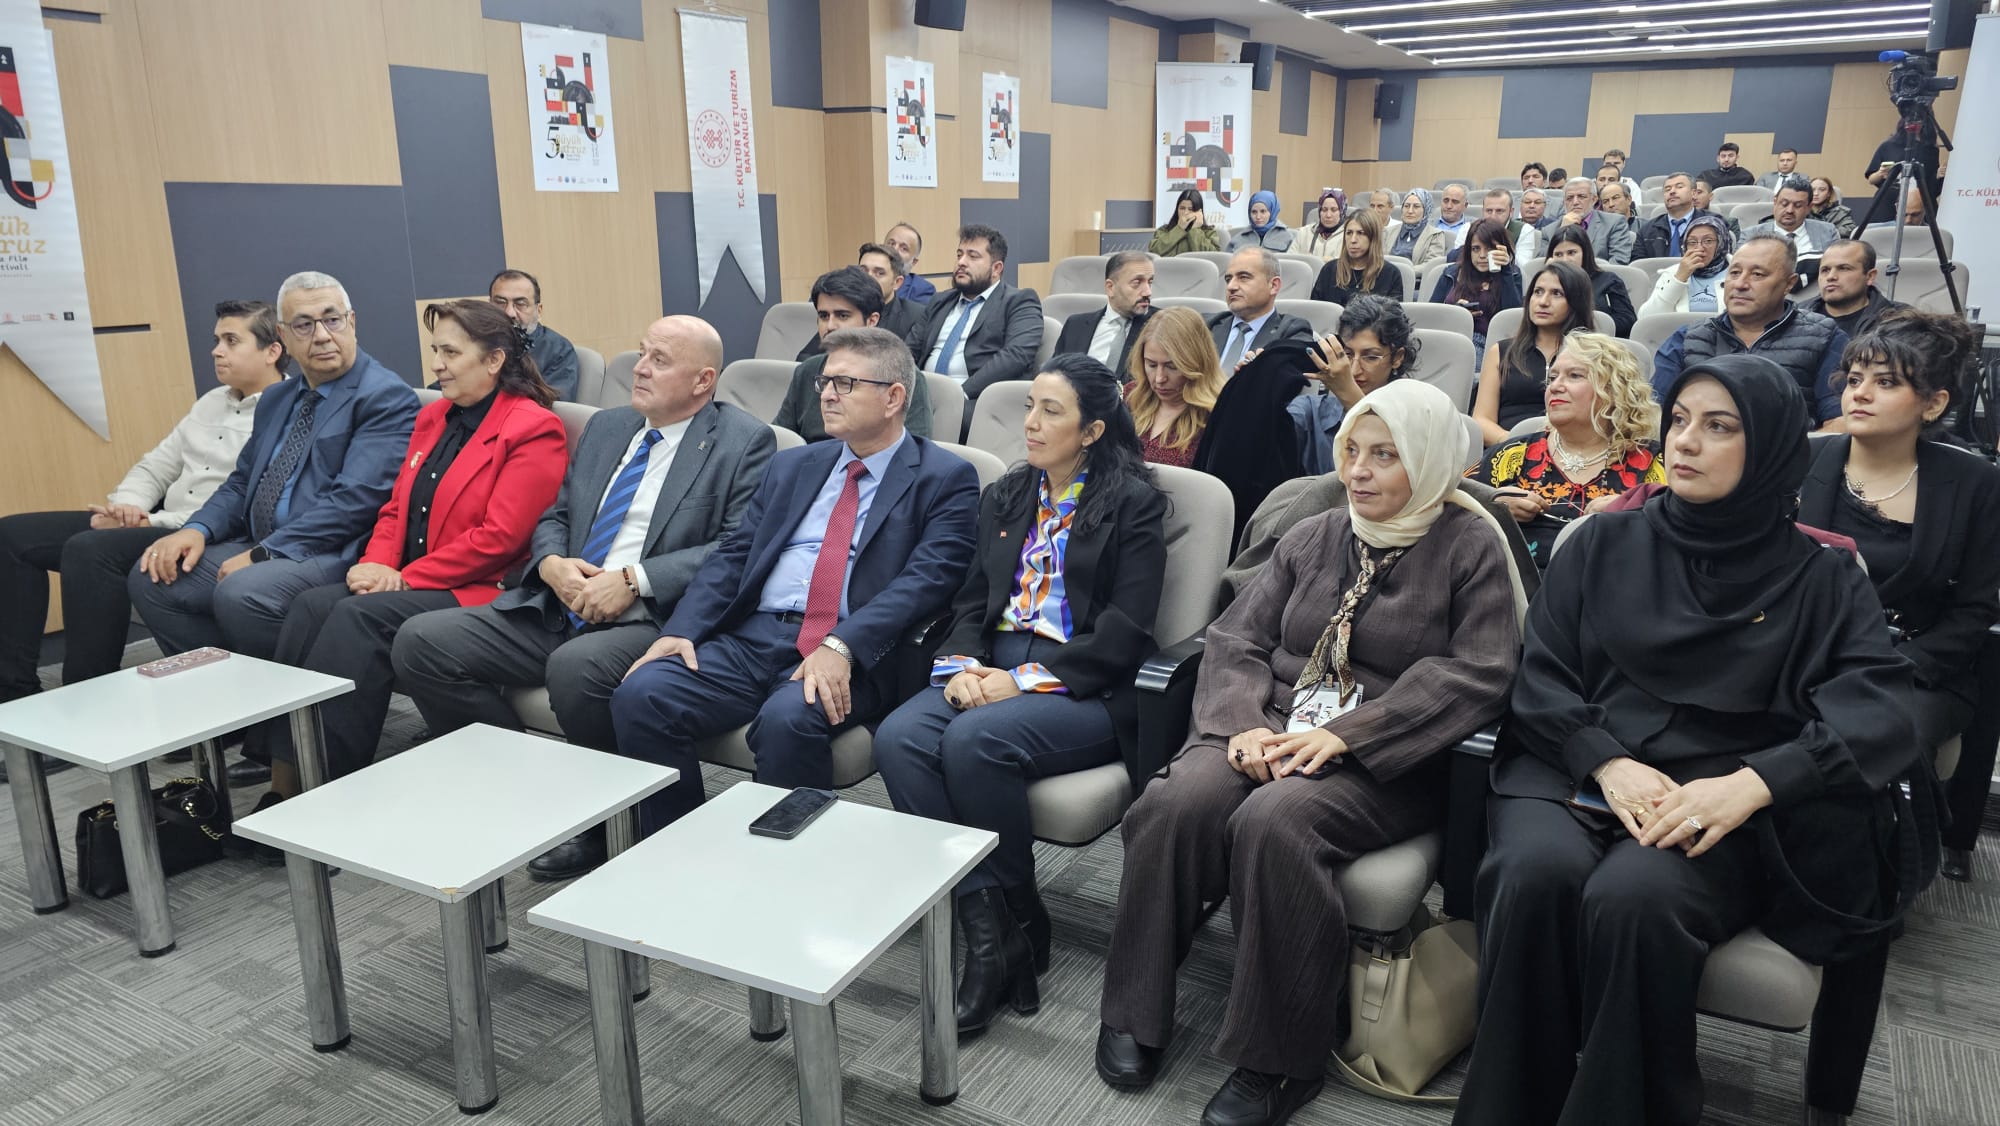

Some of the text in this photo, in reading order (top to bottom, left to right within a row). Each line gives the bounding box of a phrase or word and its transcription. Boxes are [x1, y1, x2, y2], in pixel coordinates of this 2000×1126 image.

[730, 70, 739, 116] TURİZM
[733, 120, 740, 135] VE
[733, 139, 743, 185] KÜLTÜR
[1957, 189, 1973, 197] T.C.
[1985, 198, 2000, 206] BA
